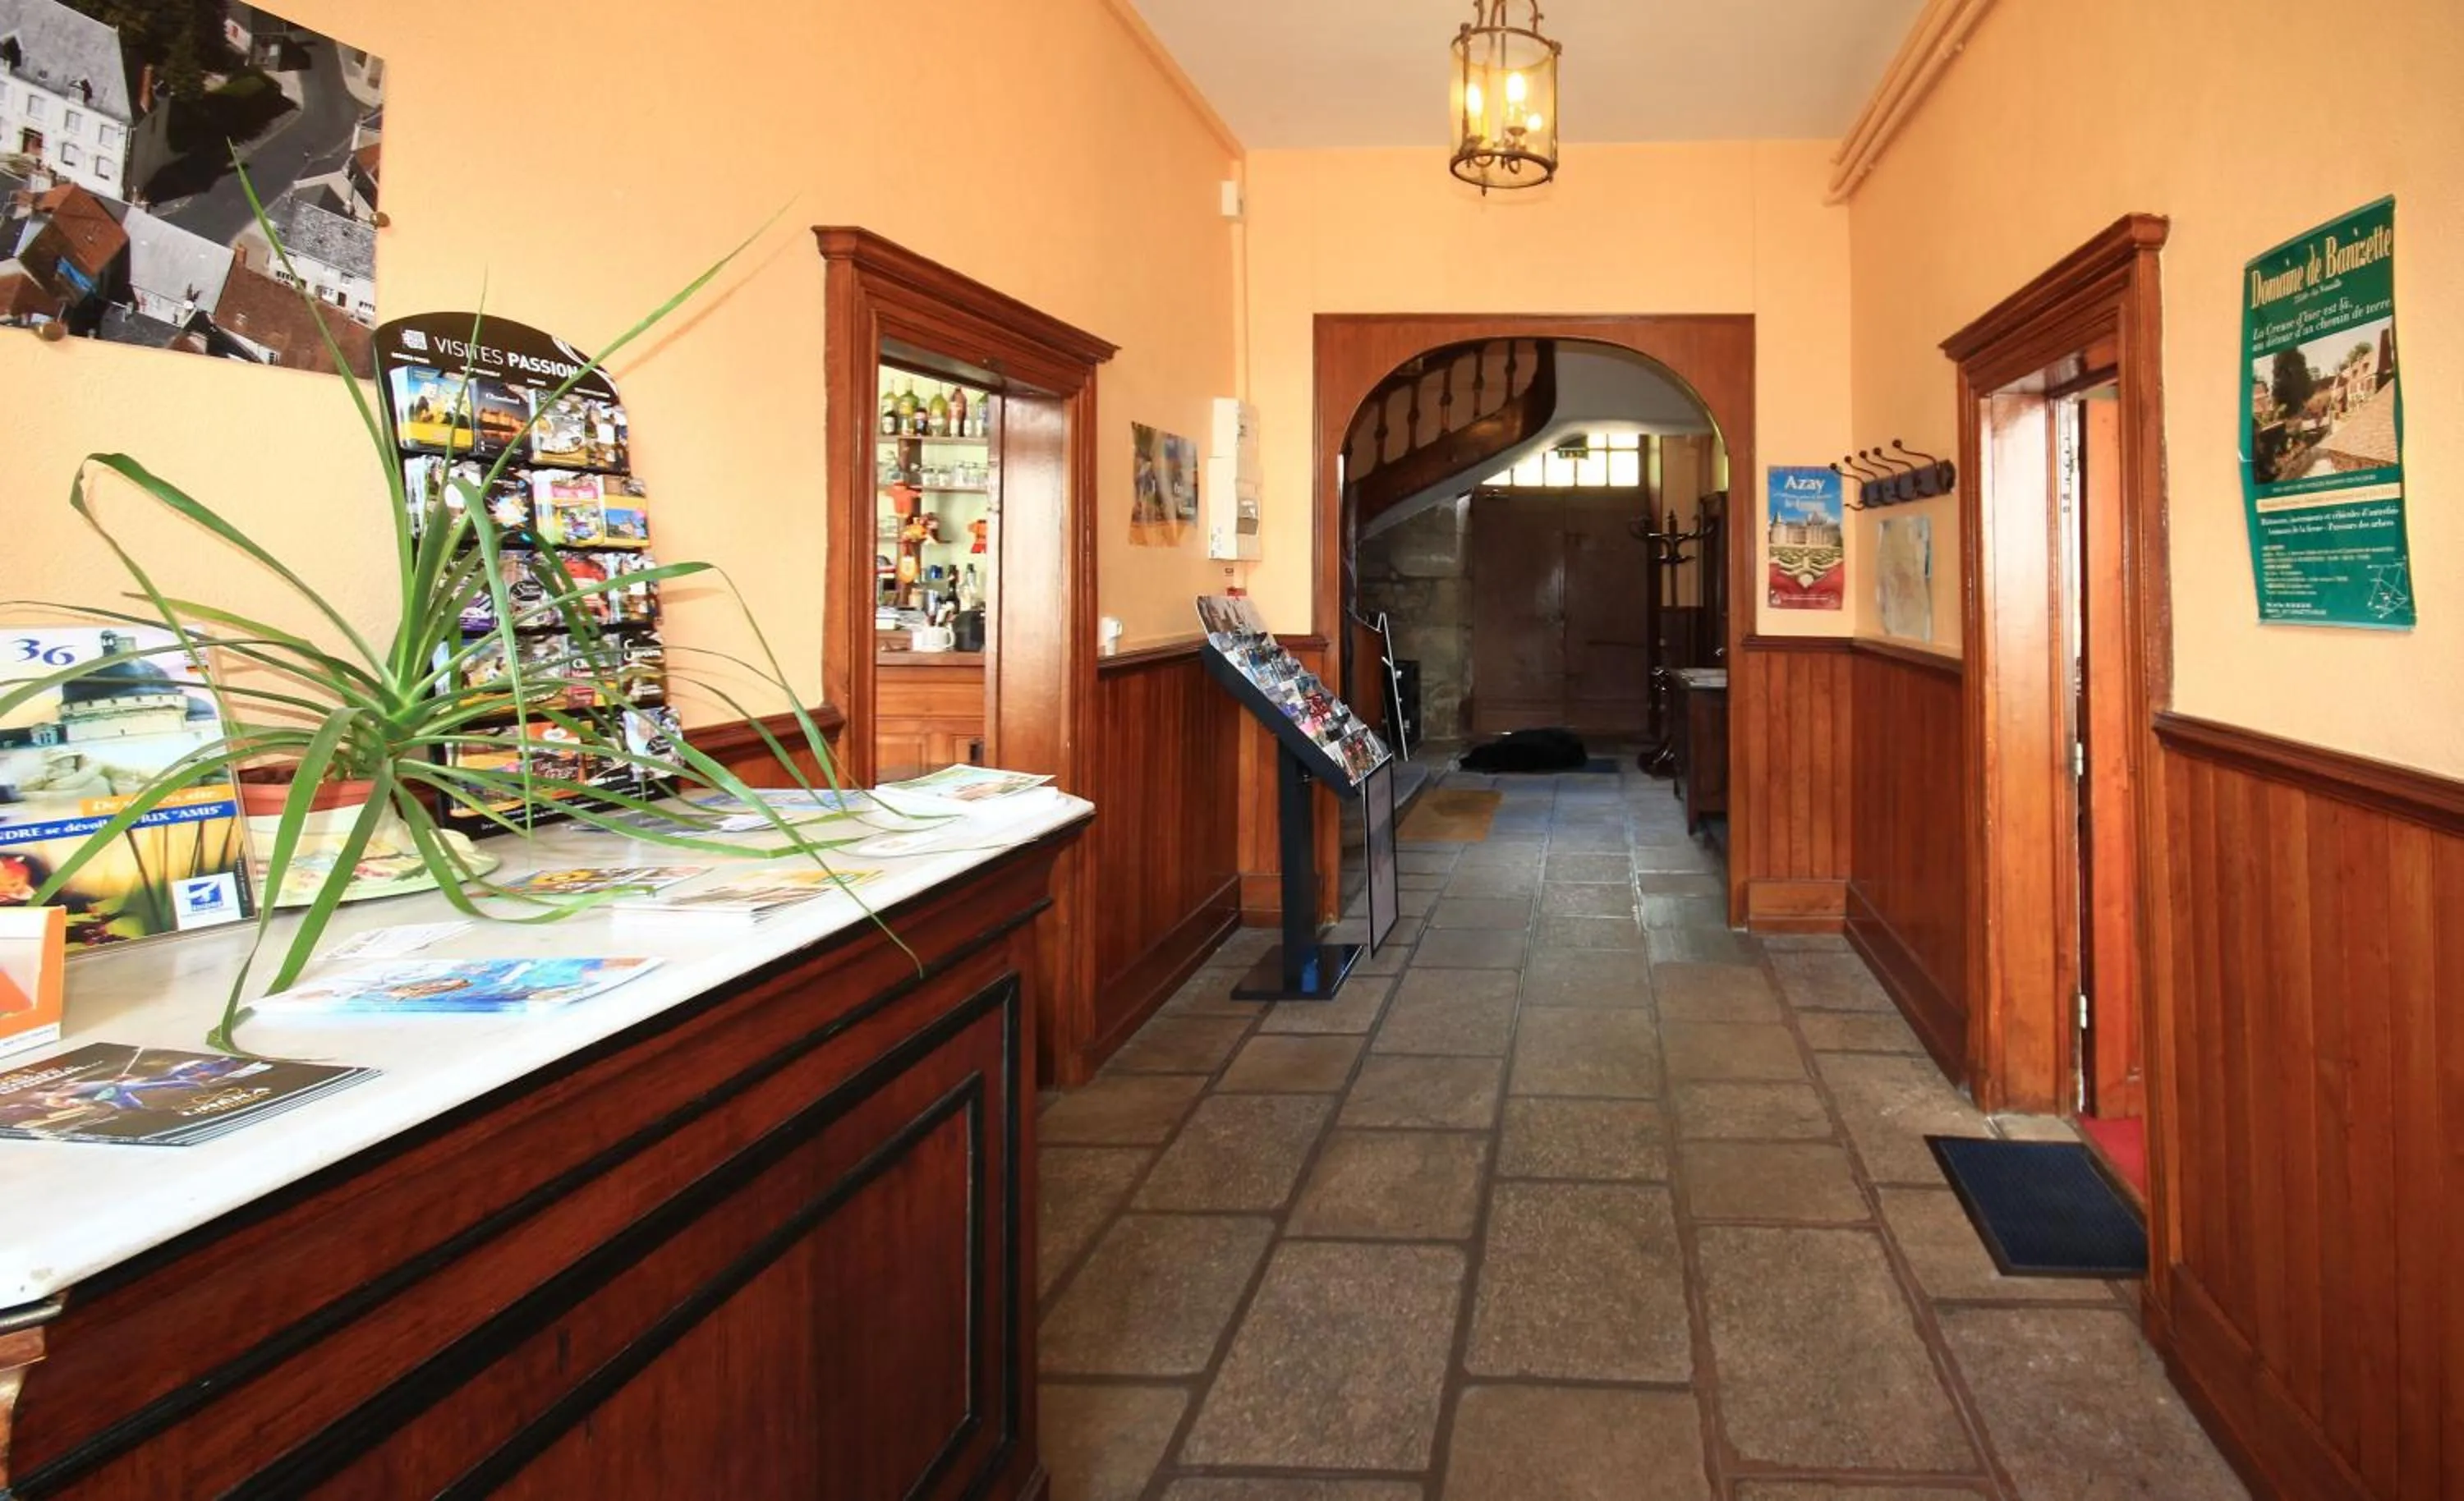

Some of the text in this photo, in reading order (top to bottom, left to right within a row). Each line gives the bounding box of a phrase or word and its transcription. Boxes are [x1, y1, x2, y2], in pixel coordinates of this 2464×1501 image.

[2251, 258, 2305, 309] Domaine
[2306, 244, 2323, 287] de
[2326, 227, 2393, 279] Banizette
[2323, 302, 2337, 316] est
[2351, 304, 2364, 319] de
[433, 335, 504, 366] VISITES
[506, 351, 580, 380] PASSION
[1786, 475, 1825, 493] Azay
[9, 638, 78, 666] 36
[132, 810, 171, 825] RIX
